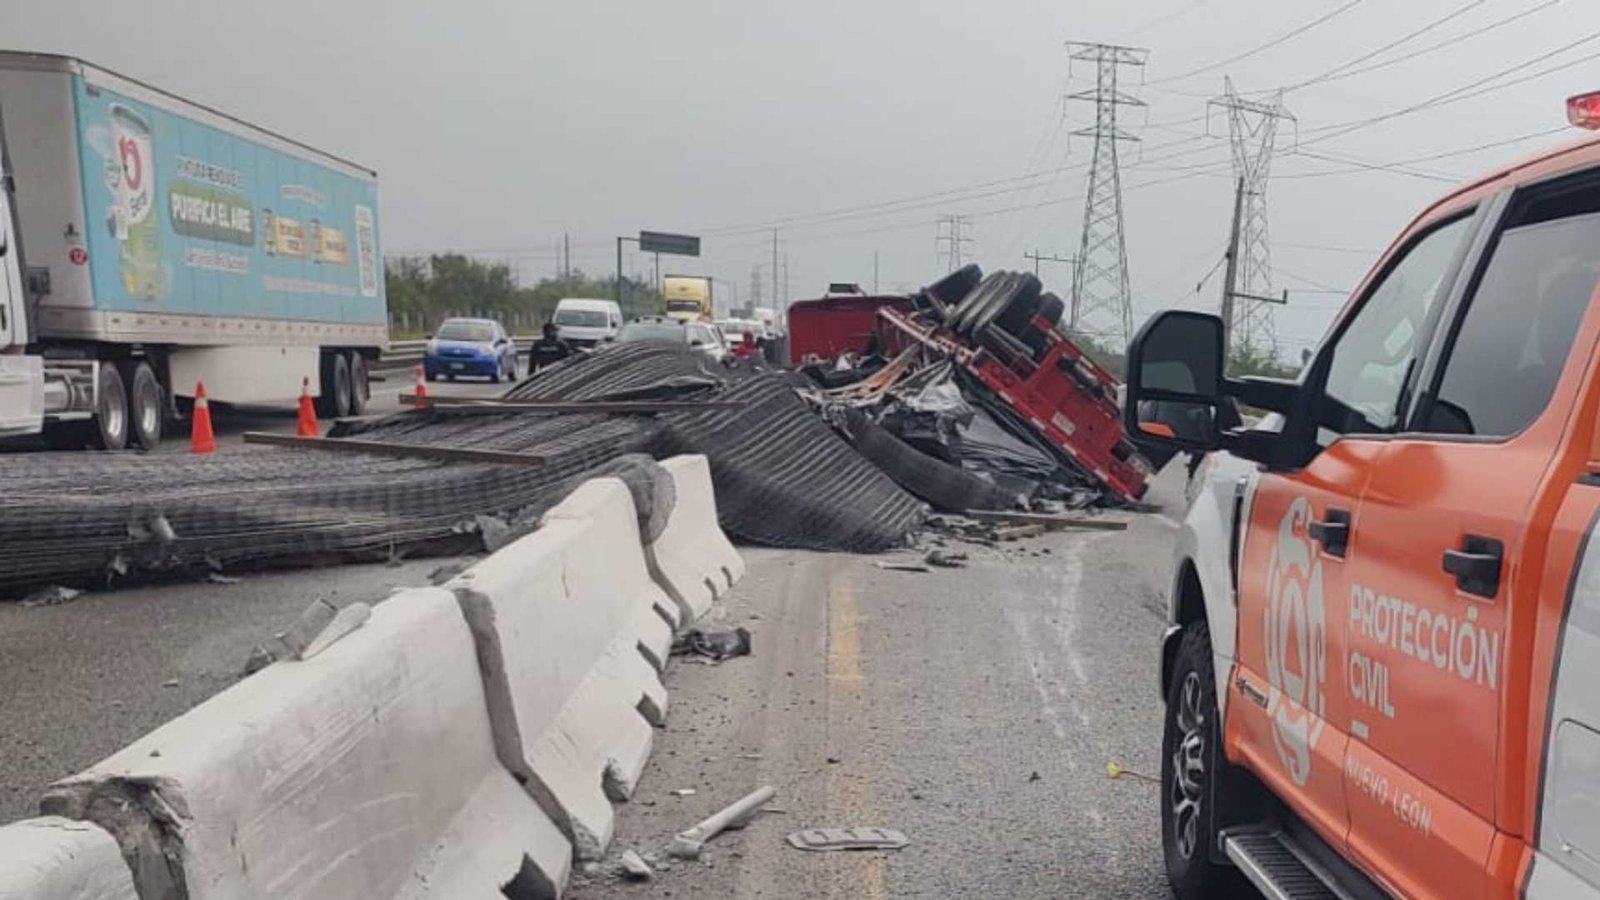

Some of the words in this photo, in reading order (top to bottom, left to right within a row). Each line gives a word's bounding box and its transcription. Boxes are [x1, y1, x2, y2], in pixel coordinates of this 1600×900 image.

[1350, 583, 1499, 690] PROTECCIÓN
[1350, 651, 1395, 719] CIVIL
[1344, 753, 1389, 806] NUEVO
